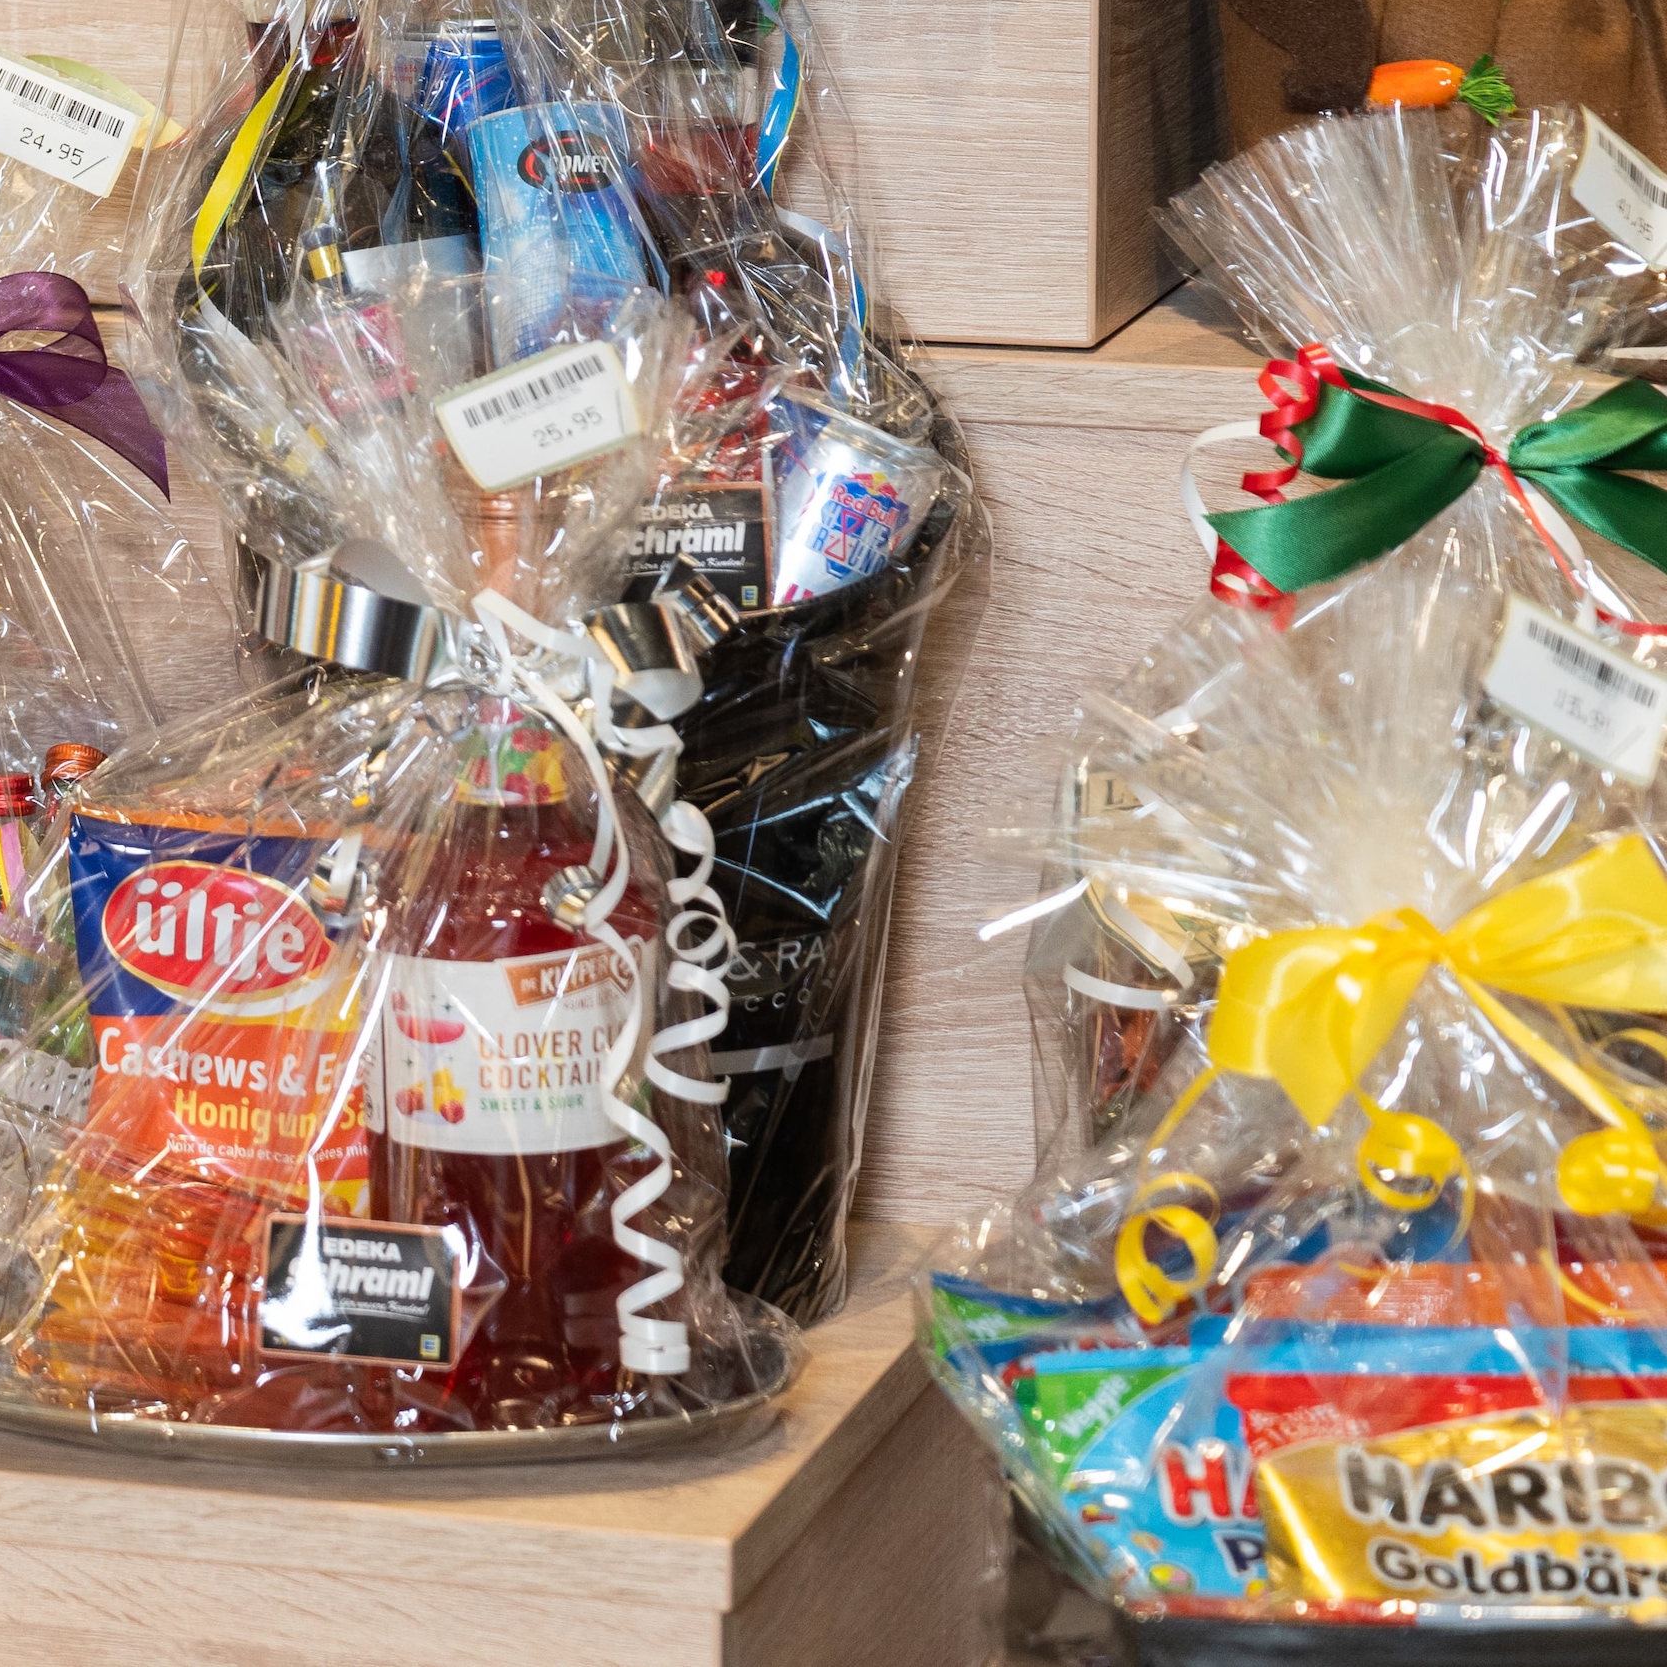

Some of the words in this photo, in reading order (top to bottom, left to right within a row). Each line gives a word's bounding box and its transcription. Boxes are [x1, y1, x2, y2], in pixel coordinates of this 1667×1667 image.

[20, 127, 85, 166] 24,95
[533, 405, 603, 449] 25,95
[639, 503, 714, 522] EDEKA
[832, 482, 867, 513] Red
[866, 495, 899, 528] Bull
[627, 521, 746, 556] chraml
[135, 878, 306, 982] ültje
[727, 941, 762, 980] &
[99, 1027, 268, 1091] Cashews
[278, 1054, 308, 1097] &
[478, 1028, 582, 1061] CLOVER
[175, 1088, 271, 1144] Honig
[479, 1097, 527, 1112] SWEET
[198, 1140, 215, 1157] de
[322, 1237, 402, 1263] EDEKA
[286, 1256, 435, 1301] hraml
[1371, 1539, 1667, 1599] Goldbär
